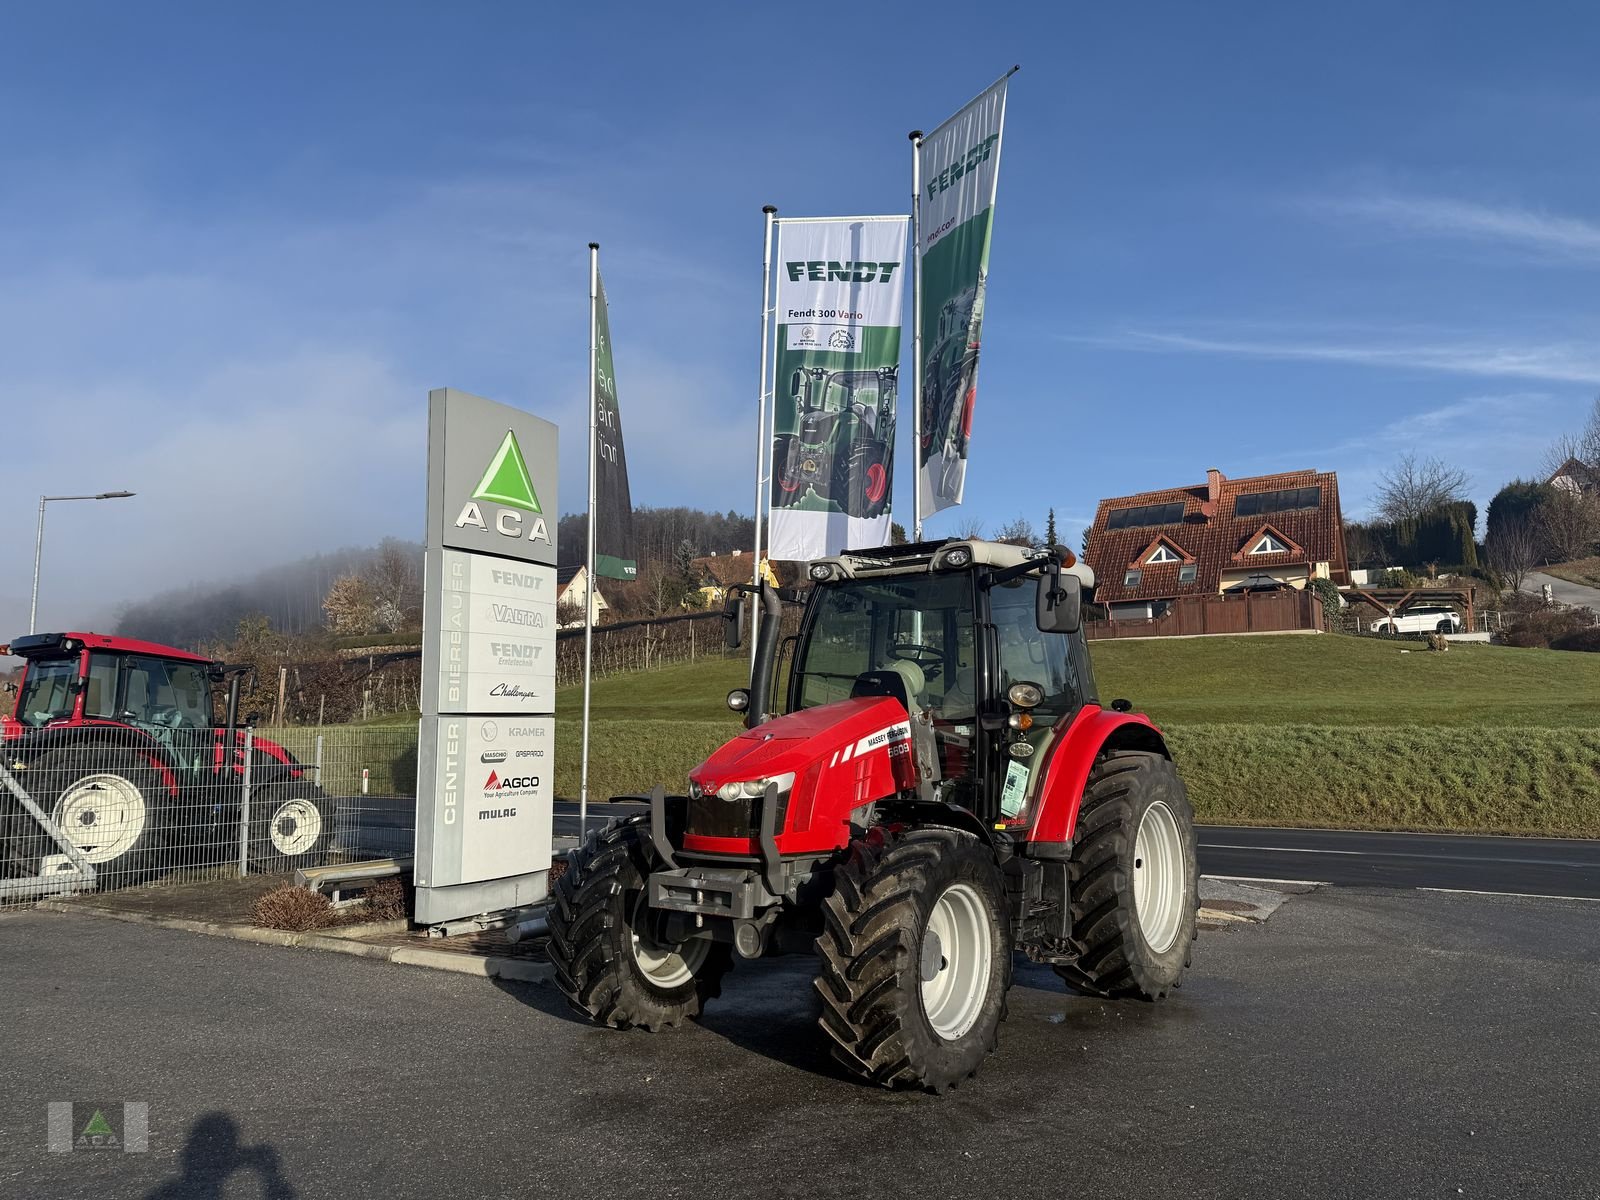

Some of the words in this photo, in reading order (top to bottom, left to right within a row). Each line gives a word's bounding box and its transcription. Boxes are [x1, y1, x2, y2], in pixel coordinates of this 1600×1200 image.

[927, 132, 999, 202] FENDT
[786, 261, 900, 283] FENDT
[788, 309, 816, 318] Fendt
[818, 310, 836, 318] 300
[838, 310, 863, 319] Vario
[454, 501, 552, 546] ACA
[491, 569, 544, 590] FENDT
[448, 561, 464, 702] BIERBAUER
[490, 642, 543, 659] FENDT
[489, 682, 541, 702] Challenger
[508, 727, 545, 737] KRAMER
[867, 735, 887, 747] MASSEY
[887, 726, 909, 740] FERGUSON
[444, 723, 459, 825] CENTER
[502, 776, 540, 789] AGCO
[495, 790, 519, 799] Agriculture
[520, 789, 538, 797] Company
